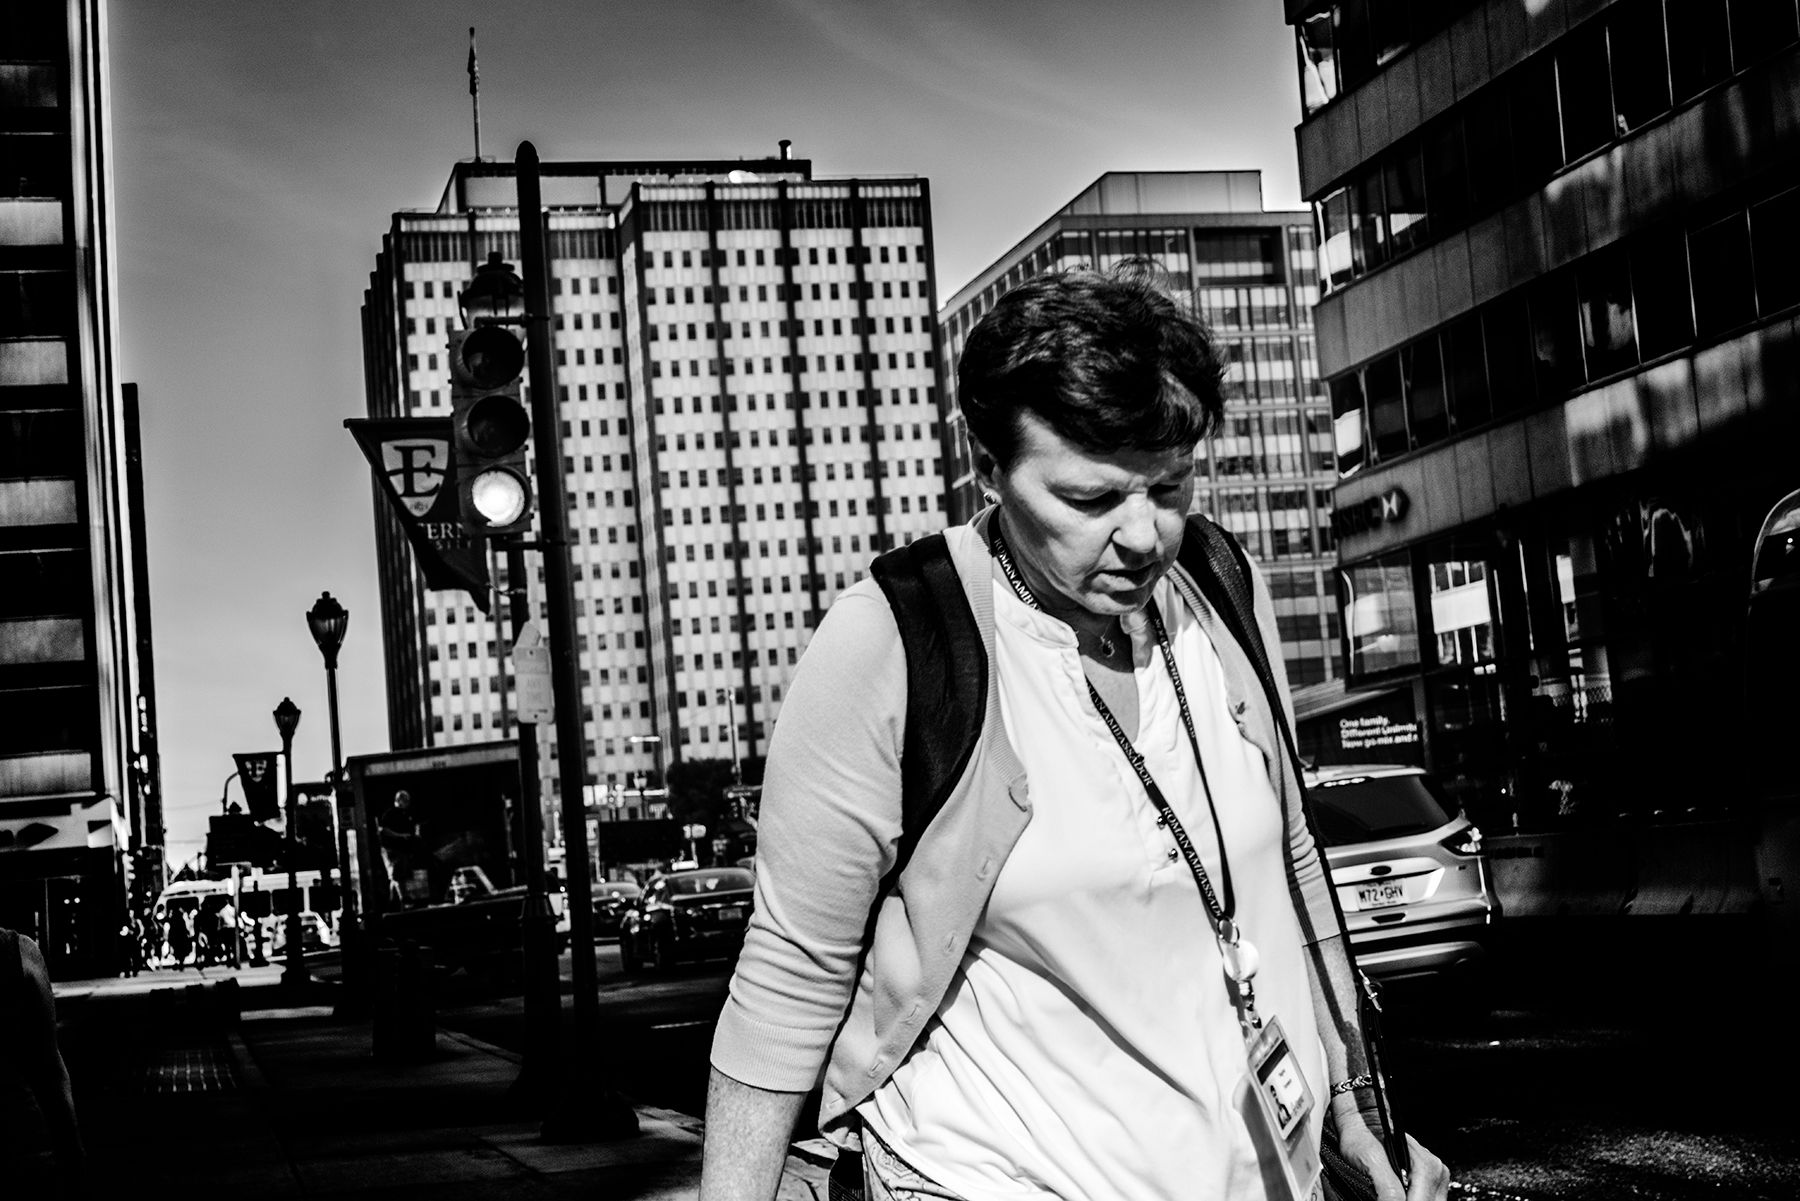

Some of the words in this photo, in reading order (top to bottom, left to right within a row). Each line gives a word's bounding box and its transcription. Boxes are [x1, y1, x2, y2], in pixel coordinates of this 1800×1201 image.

[1339, 718, 1359, 729] One
[1103, 711, 1152, 787] AMBASSADOR
[1161, 806, 1191, 850] ROMAN
